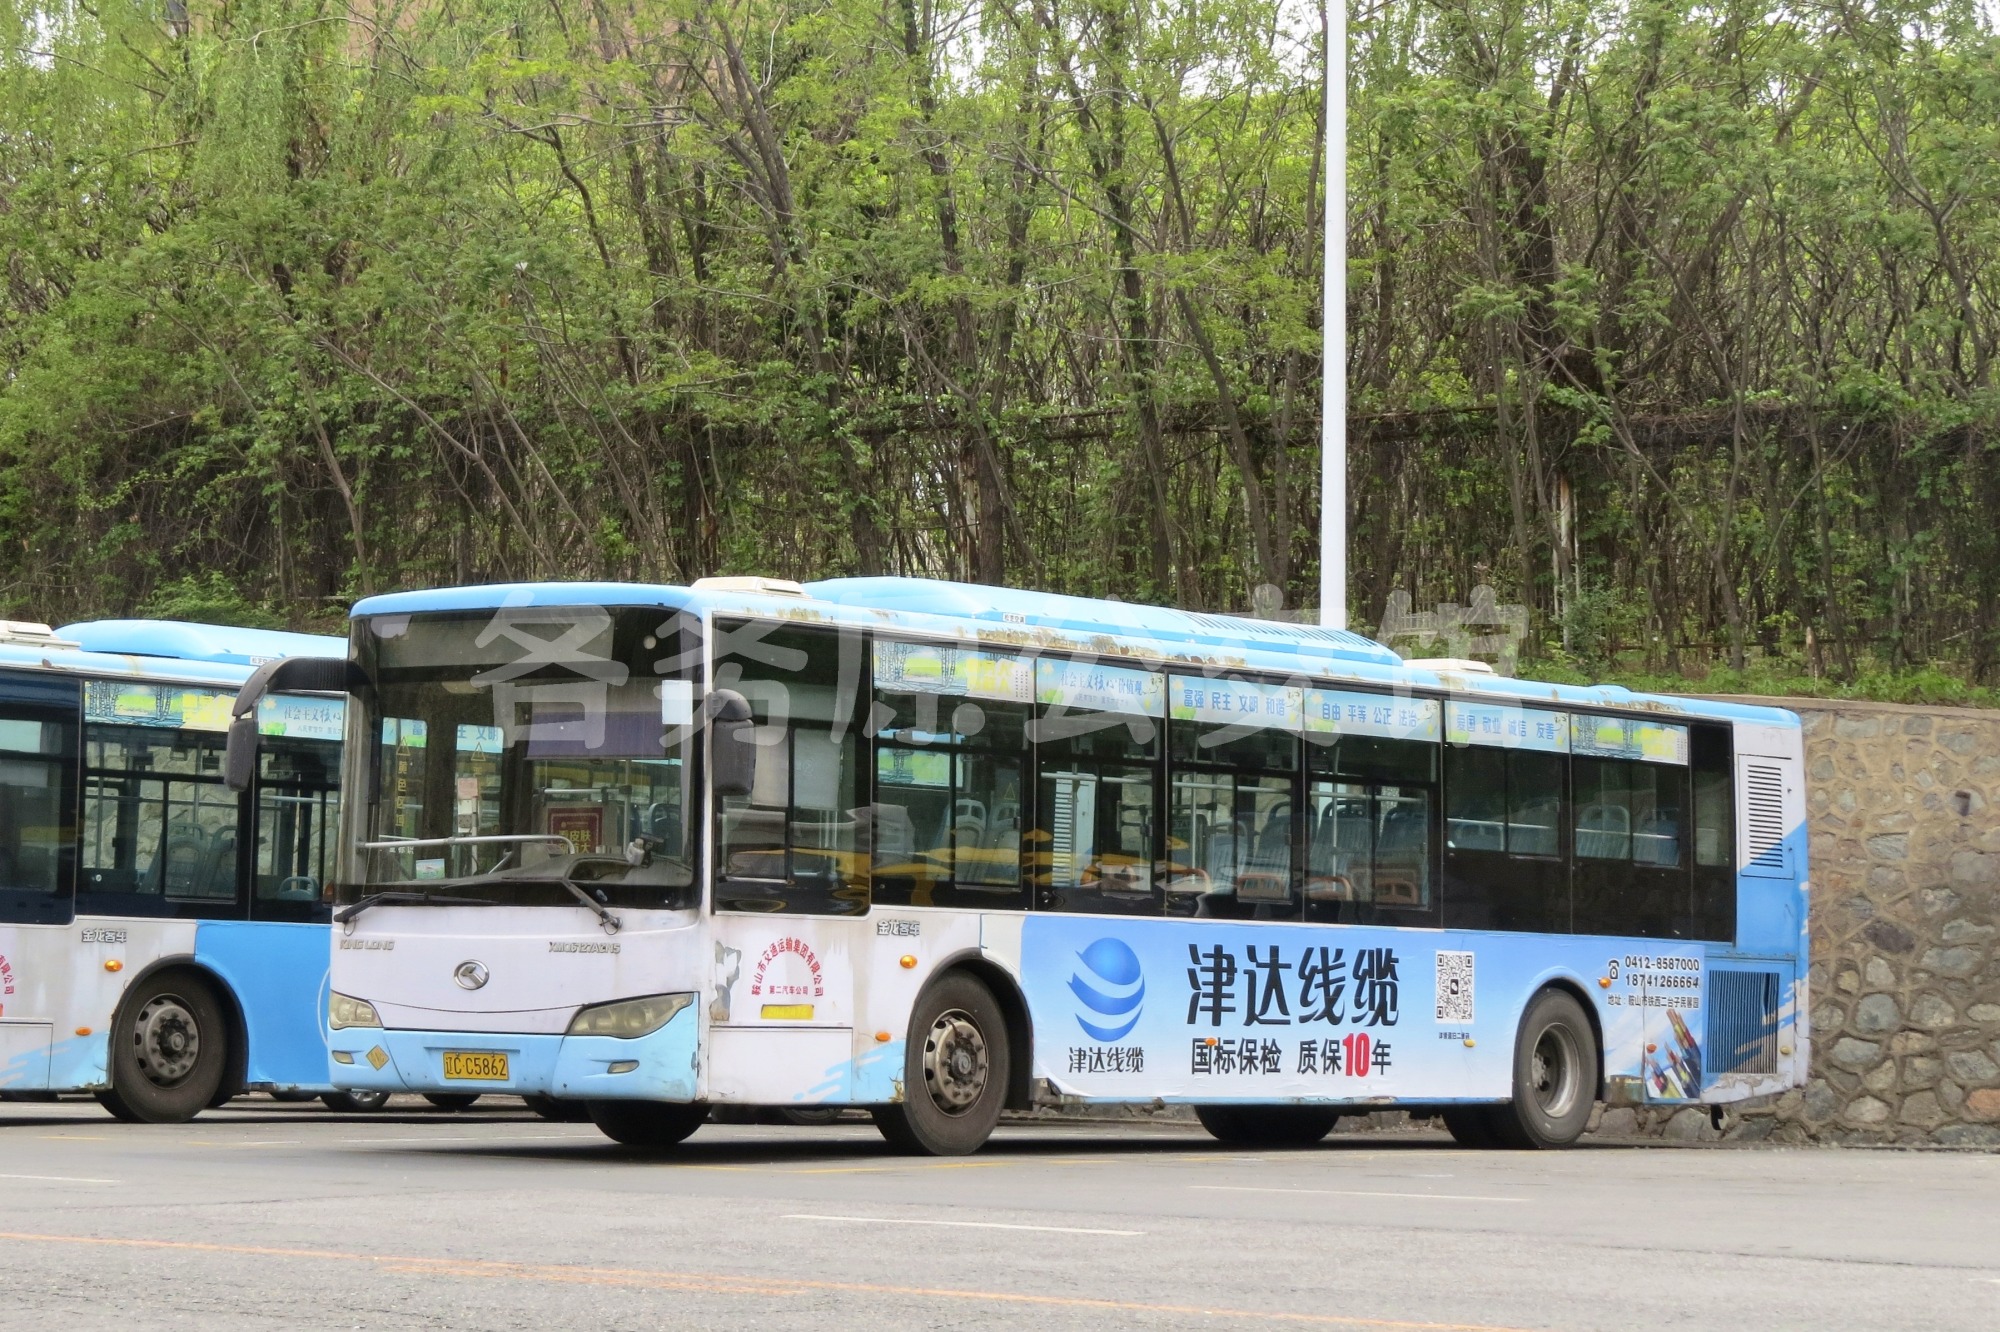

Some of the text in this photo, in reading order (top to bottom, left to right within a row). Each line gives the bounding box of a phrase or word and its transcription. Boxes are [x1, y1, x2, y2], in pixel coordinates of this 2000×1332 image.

[1183, 688, 1285, 717] 富强 民主 文明 和谐
[1321, 701, 1417, 728] 自由 平等 公正 法治
[1456, 714, 1555, 740] 爱国 敬业 诚信 友善
[81, 928, 127, 943] 金龙客车
[876, 919, 920, 936] 金龙客车
[339, 939, 395, 951] KING LONG
[751, 936, 824, 997] 鞍山市交通运输集团有限公司
[1624, 956, 1700, 971] 0412-8587000
[769, 985, 809, 995] 第二汽车公司
[1187, 943, 1400, 1027] 津达线缆
[1625, 973, 1700, 988] 18741266664
[1068, 1046, 1145, 1073] 津达线缆
[1191, 1032, 1392, 1078] 国标保检 质保10年
